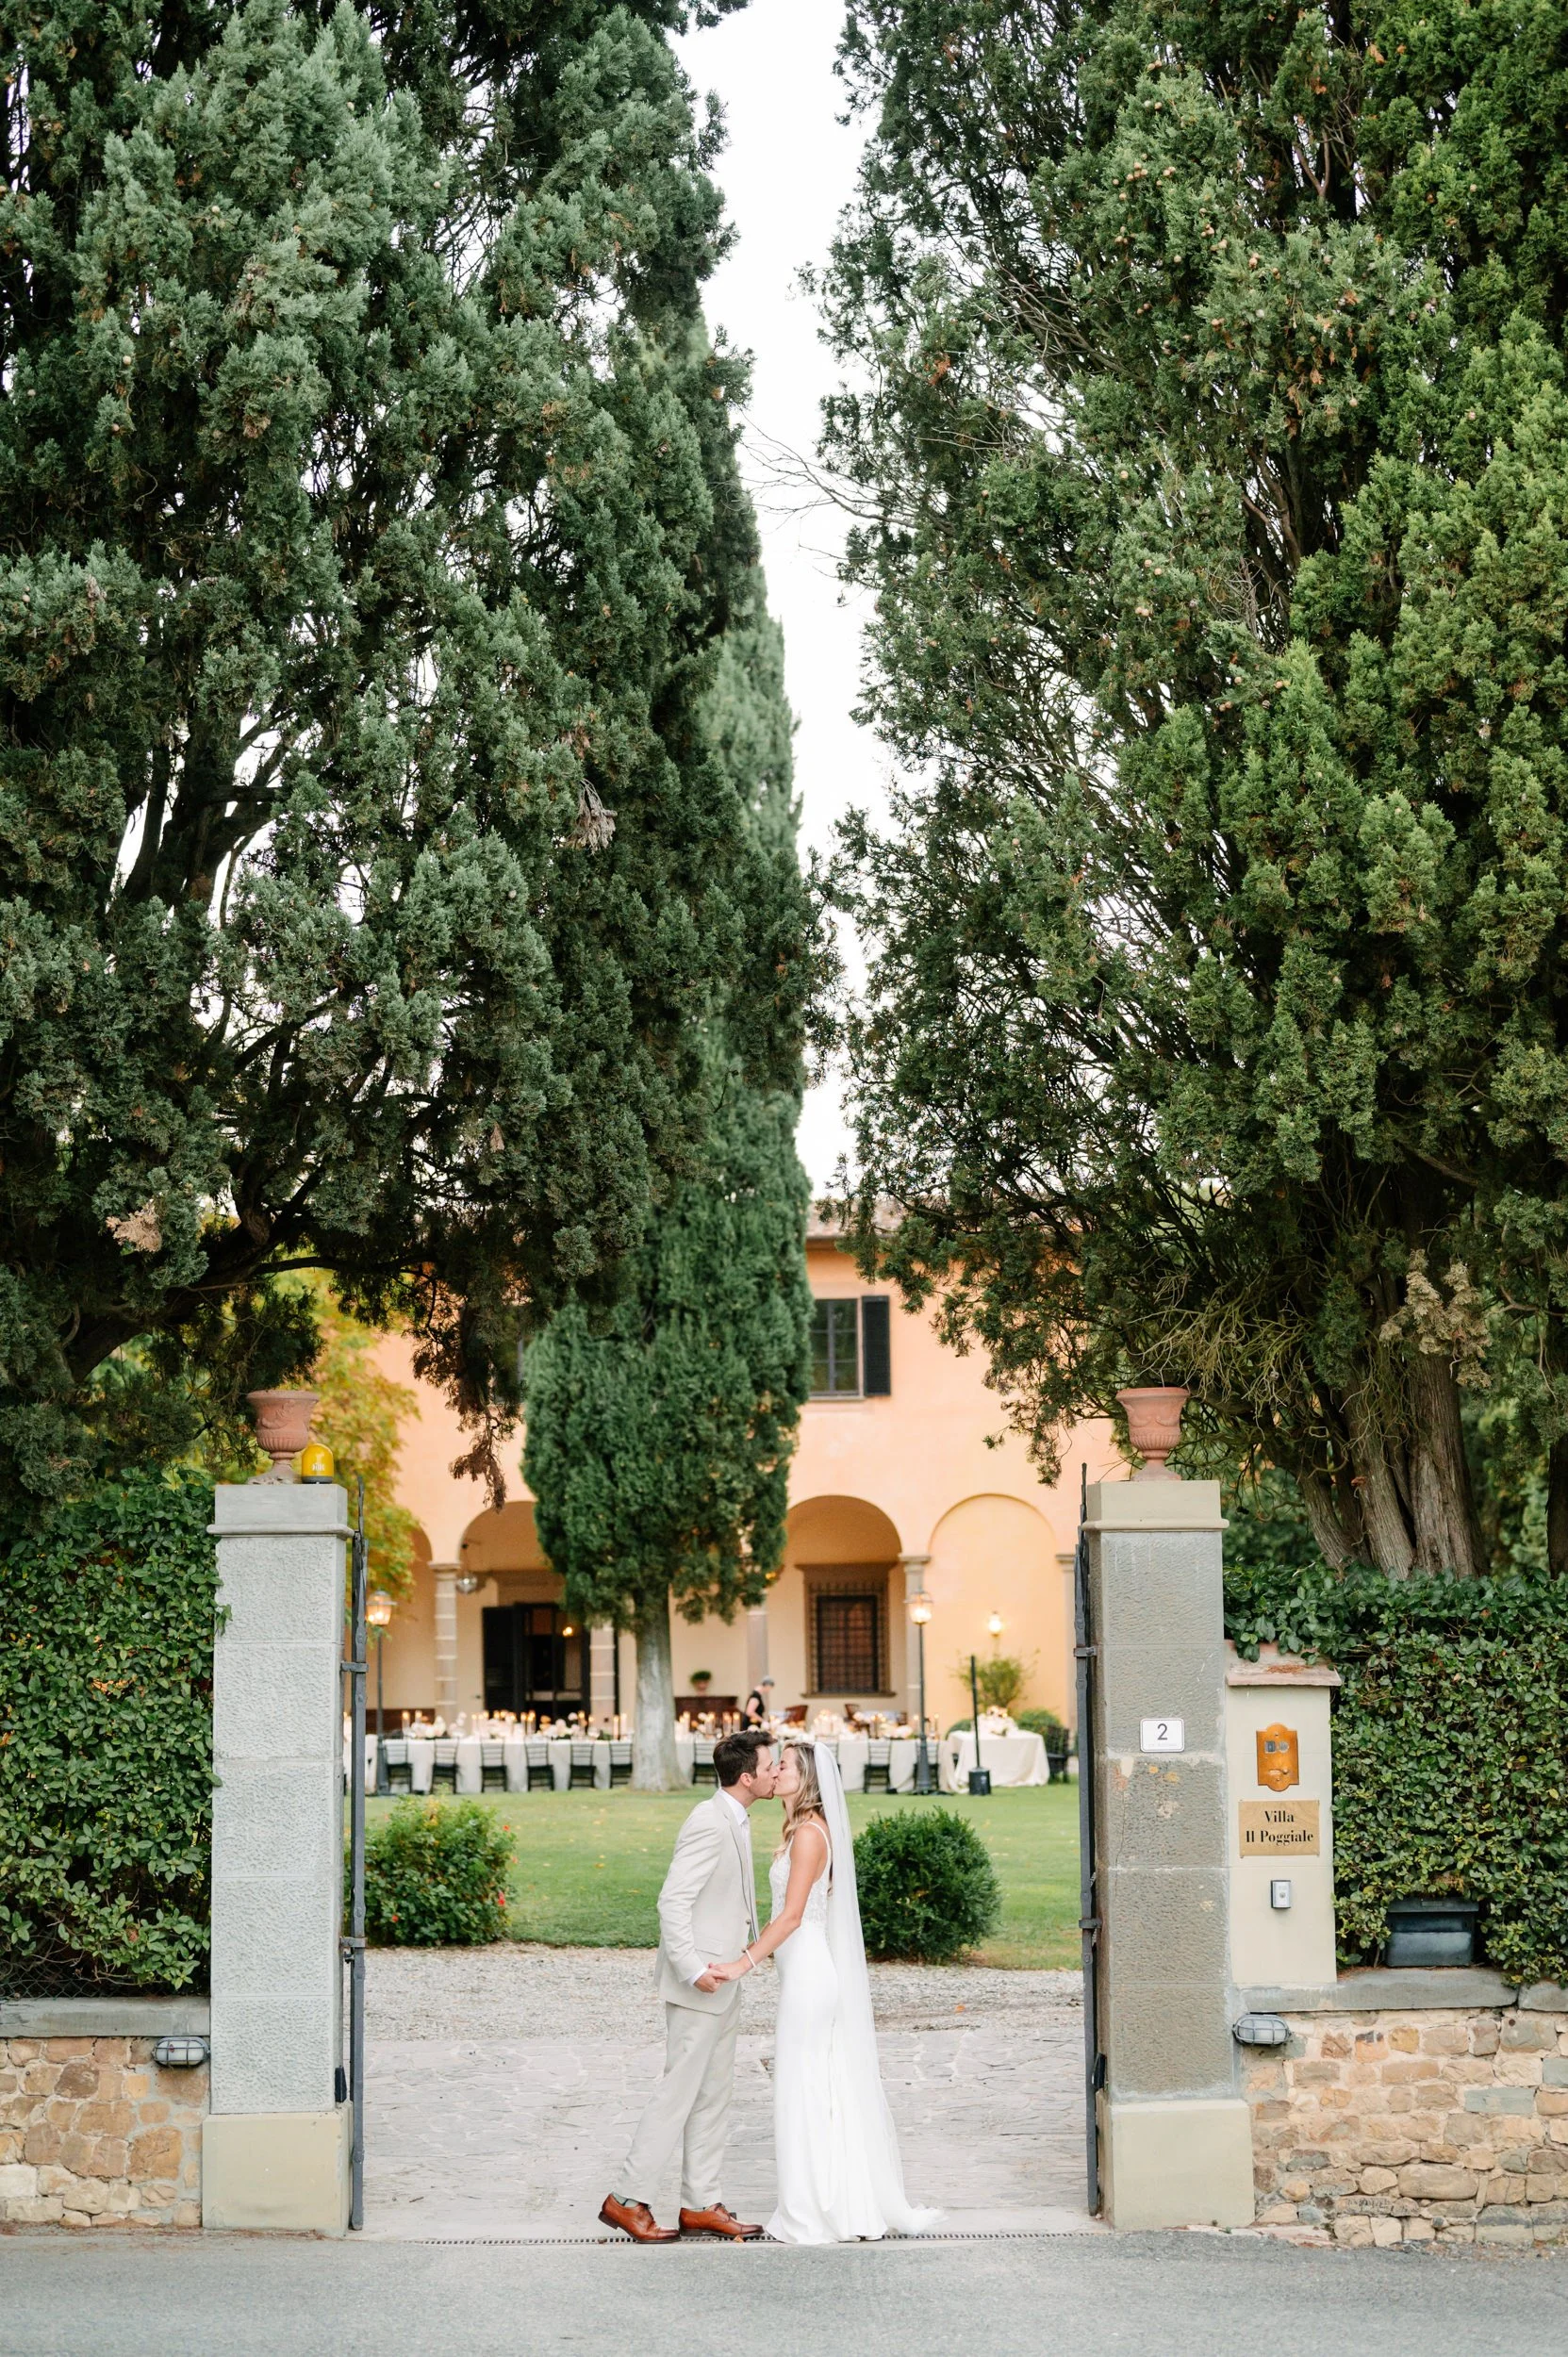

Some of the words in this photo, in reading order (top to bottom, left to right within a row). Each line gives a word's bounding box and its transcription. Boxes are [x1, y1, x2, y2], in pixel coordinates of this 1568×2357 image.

[1157, 1722, 1168, 1740] 2
[1264, 1810, 1294, 1822] Villa
[1246, 1830, 1255, 1843] Il
[1261, 1829, 1314, 1846] Poggiale
